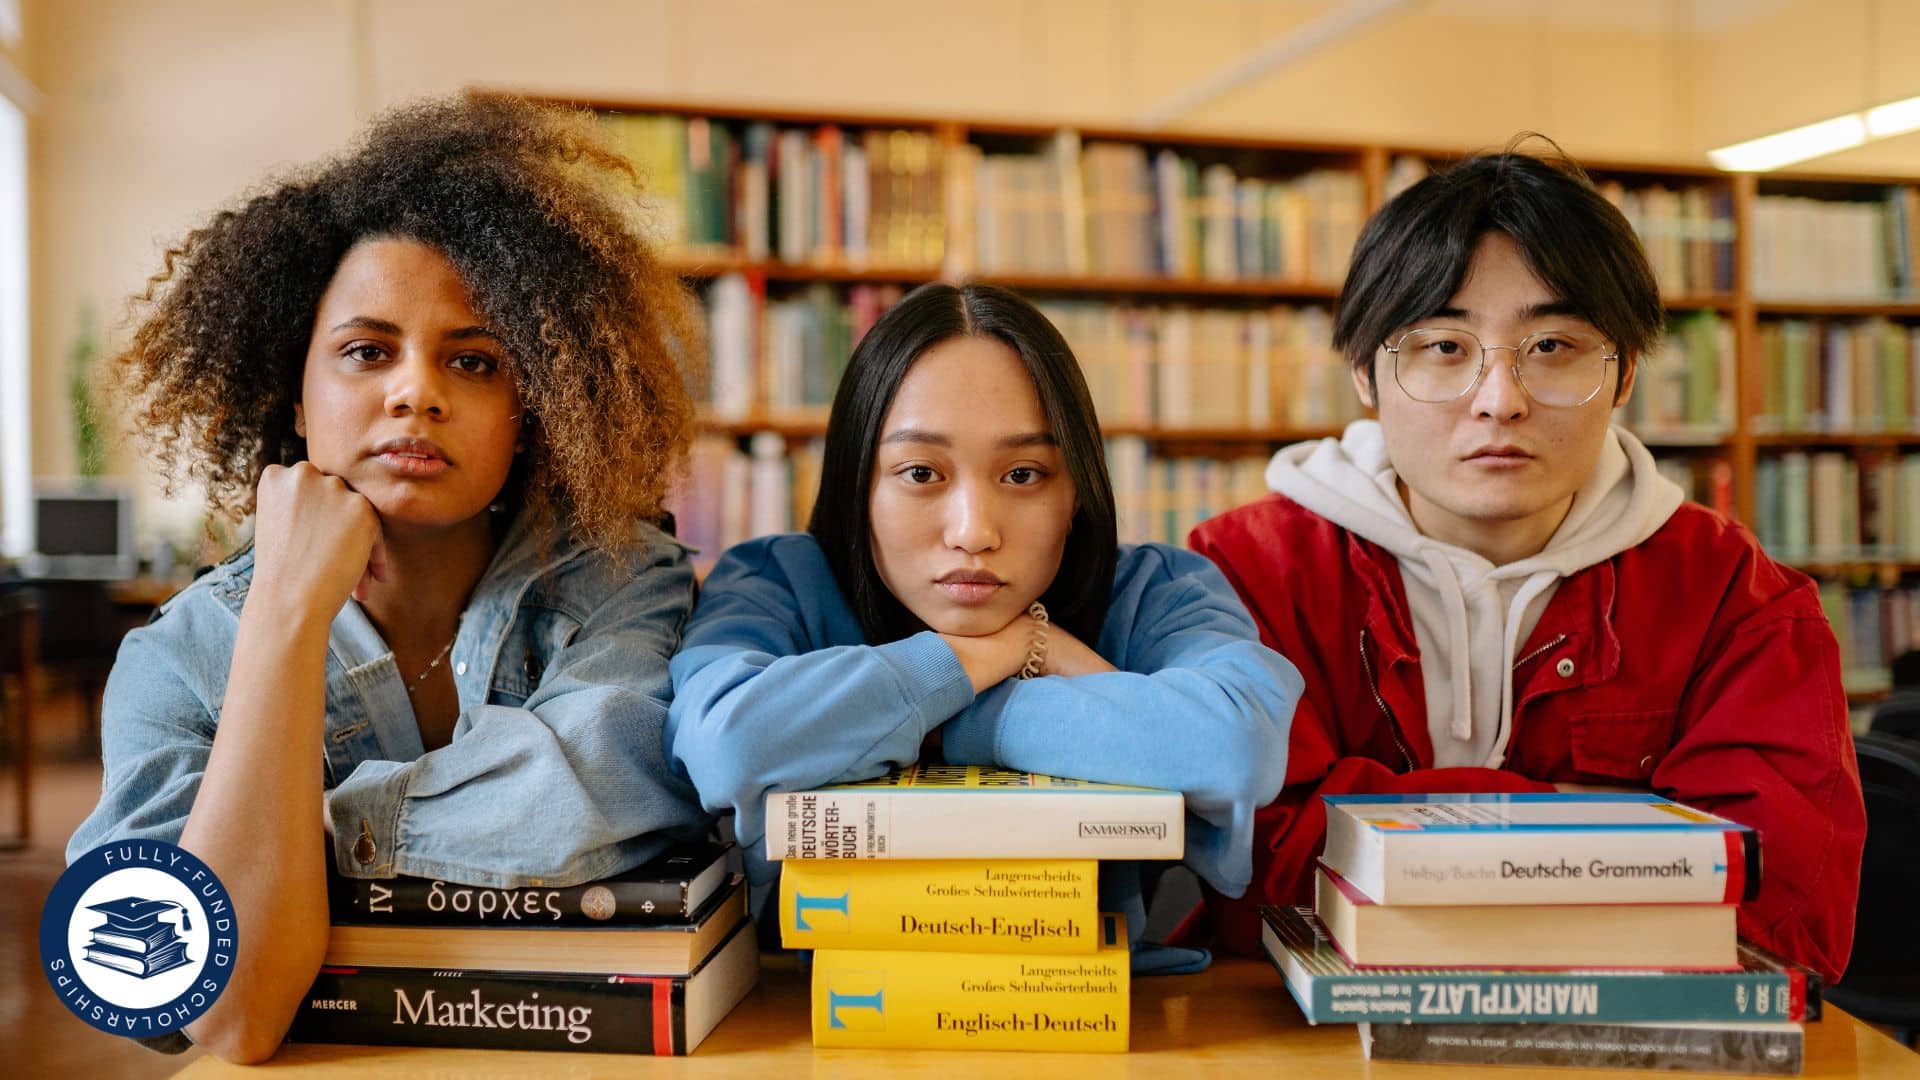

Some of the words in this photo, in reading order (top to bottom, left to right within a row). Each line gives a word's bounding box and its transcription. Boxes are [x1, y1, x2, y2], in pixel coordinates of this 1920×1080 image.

[786, 795, 798, 819] große
[788, 822, 797, 842] neue
[802, 795, 816, 859] DEUTSCHE
[821, 801, 839, 859] WÖRTER-
[842, 826, 857, 859] BUCH
[985, 868, 1082, 885] Langenscheidts
[1501, 857, 1583, 879] Deutsche
[1588, 856, 1693, 879] Grammatik
[926, 884, 970, 898] Großes
[974, 883, 1081, 899] Schulwörterbuch
[901, 914, 1080, 942] Deutsch-Englisch
[1020, 964, 1117, 981] Langenscheidts
[961, 980, 1006, 995] Großes
[1009, 980, 1117, 995] Schulwörterbuch
[1419, 984, 1597, 1015] MARKTPLATZ
[312, 999, 358, 1011] MERCER
[392, 988, 593, 1043] Marketing
[936, 1012, 1117, 1037] Englisch-Deutsch
